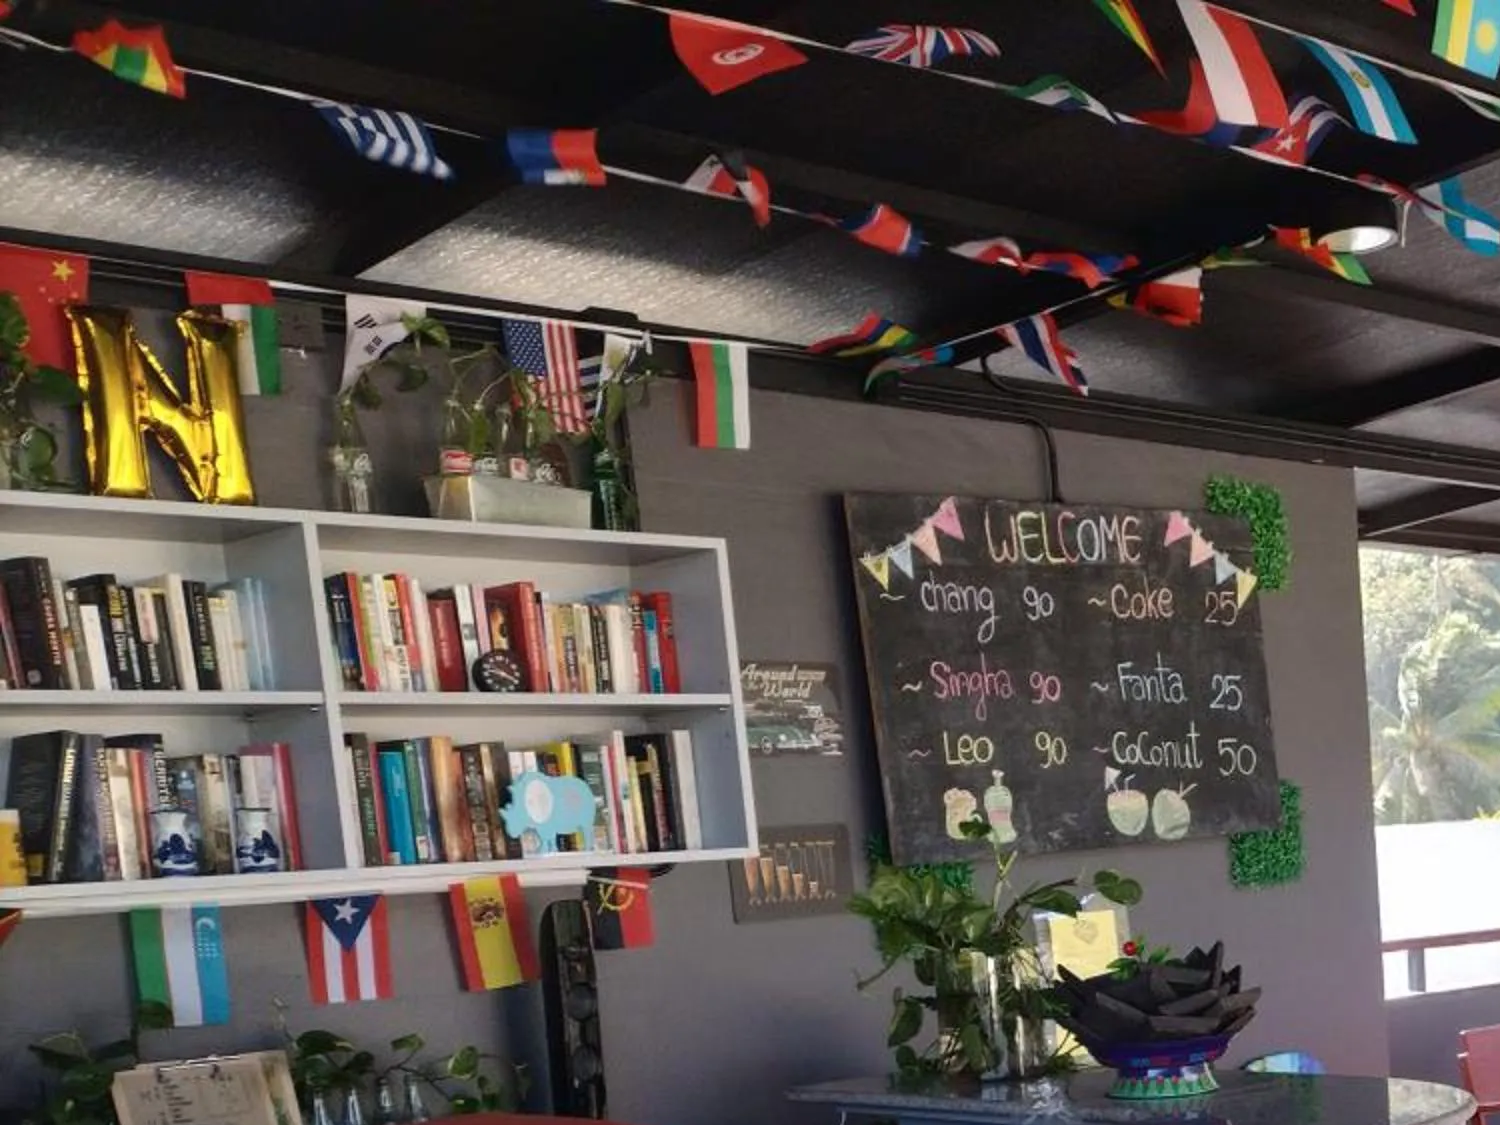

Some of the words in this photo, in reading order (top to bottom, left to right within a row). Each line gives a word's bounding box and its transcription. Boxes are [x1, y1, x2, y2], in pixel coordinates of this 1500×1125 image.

[63, 303, 256, 505] N
[983, 510, 1144, 566] WELCOME
[1022, 585, 1055, 621] 90
[1110, 582, 1175, 620] Coke
[1204, 590, 1238, 626] 25
[929, 652, 1015, 722] Singha
[1029, 671, 1061, 704] 90
[1117, 652, 1188, 704] Fanta
[1209, 674, 1243, 711] 25
[943, 731, 994, 766] Leo
[1034, 731, 1068, 767] 90
[1217, 737, 1257, 777] 50
